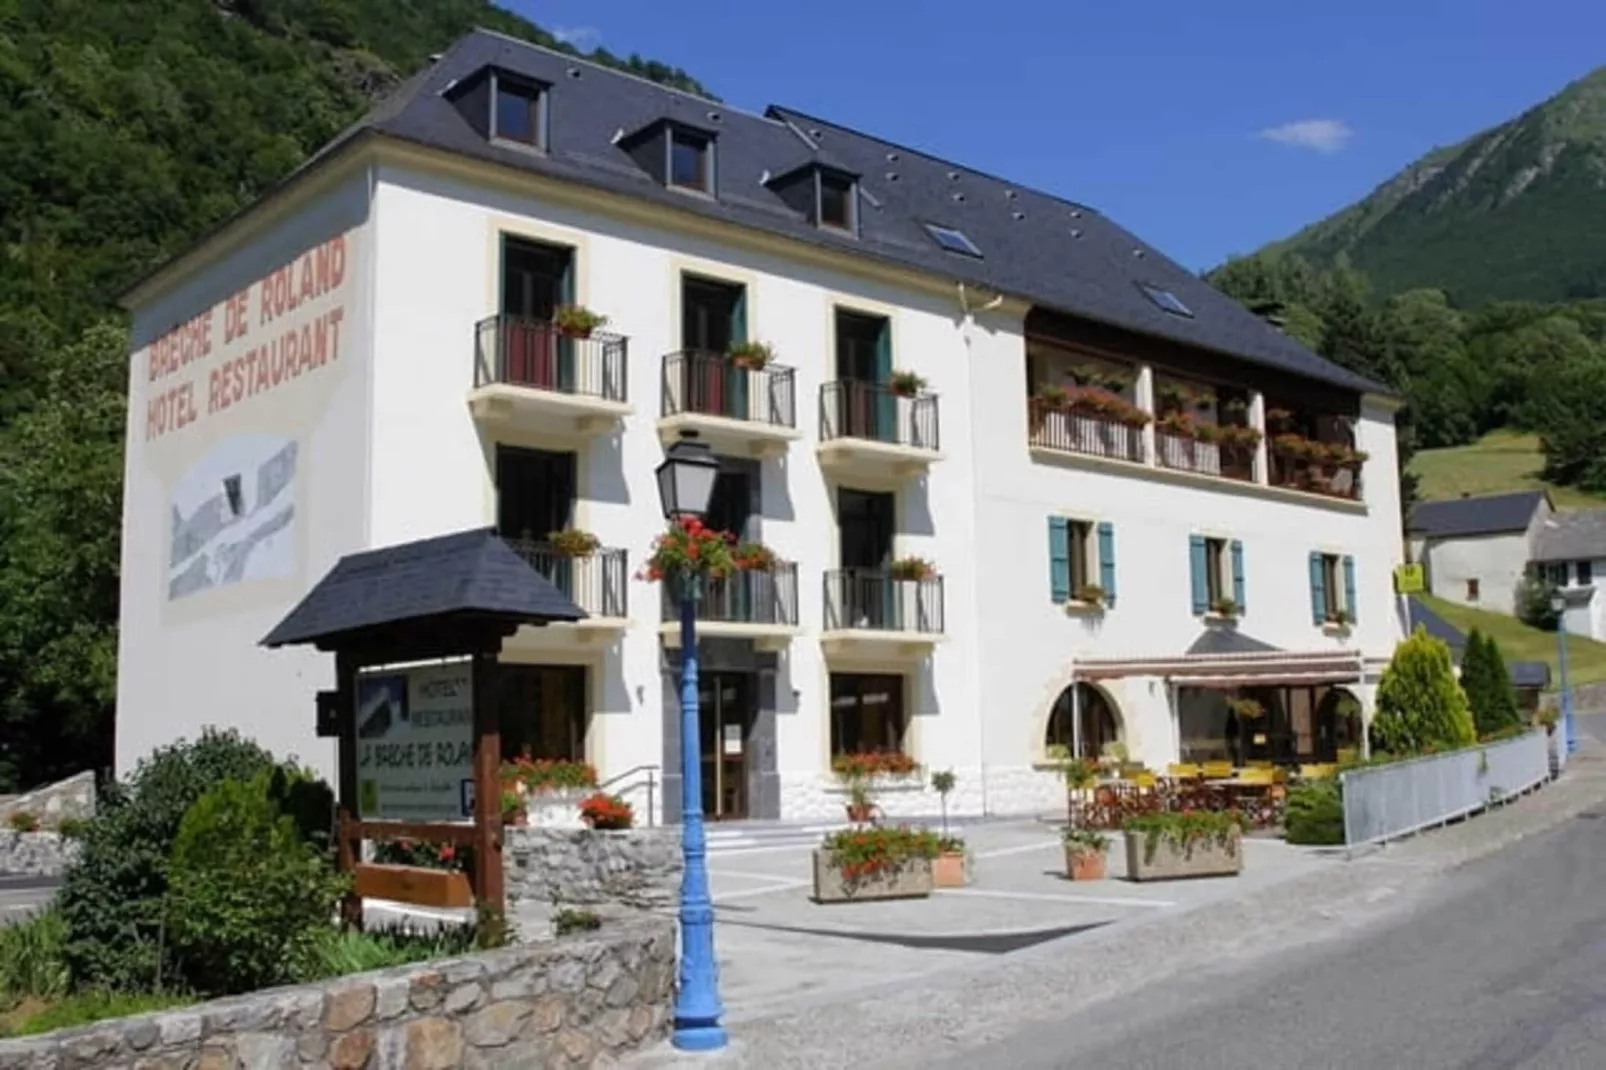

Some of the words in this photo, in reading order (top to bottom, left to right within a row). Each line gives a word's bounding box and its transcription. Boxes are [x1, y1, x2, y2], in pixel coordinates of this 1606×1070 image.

[224, 291, 249, 345] DE
[260, 234, 345, 328] ROLAND
[208, 305, 344, 414] RESTAURANT
